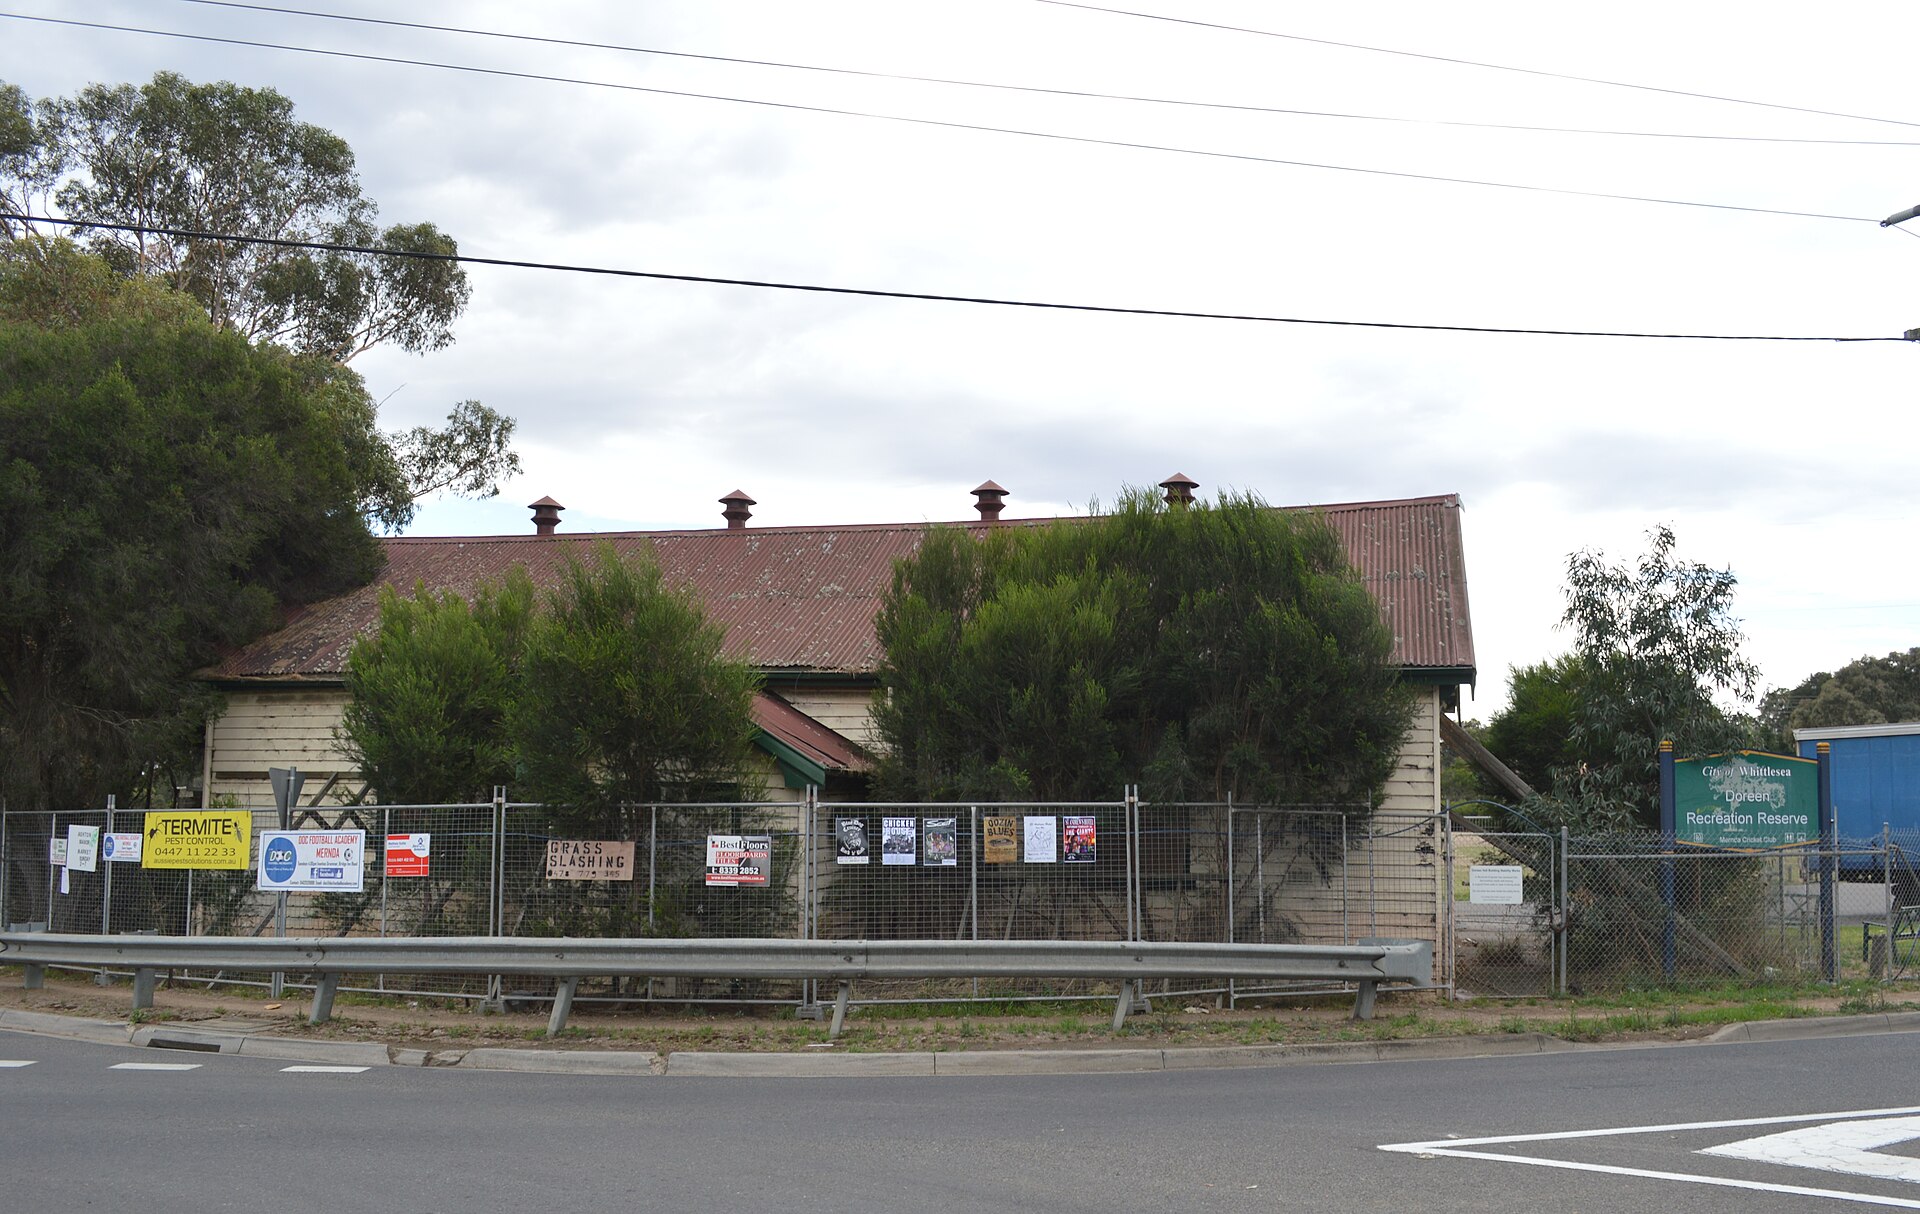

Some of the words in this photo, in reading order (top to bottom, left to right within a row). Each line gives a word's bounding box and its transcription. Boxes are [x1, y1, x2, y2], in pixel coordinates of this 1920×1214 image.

[1702, 766, 1722, 777] City
[1725, 766, 1734, 777] of
[1740, 765, 1792, 777] Whittlesea
[1725, 790, 1770, 802] Doreen
[883, 820, 914, 828] CHICKEN
[1686, 812, 1753, 825] Recreation
[1757, 812, 1808, 825] Reserve
[162, 818, 232, 835] TERMITE
[987, 826, 1015, 837] BLUES
[165, 837, 184, 845] PEST
[186, 837, 226, 845] CONTROL
[309, 835, 333, 844] FOOTBALL
[334, 835, 358, 844] ACADEMY
[720, 841, 739, 849] Best
[740, 841, 769, 849] Floors
[154, 847, 183, 856] 0447
[187, 847, 200, 856] 11
[204, 847, 218, 856] 22
[221, 847, 236, 856] 33
[316, 847, 339, 858] MERNDA
[551, 841, 603, 855] GRASS
[550, 855, 625, 868] SLASHING
